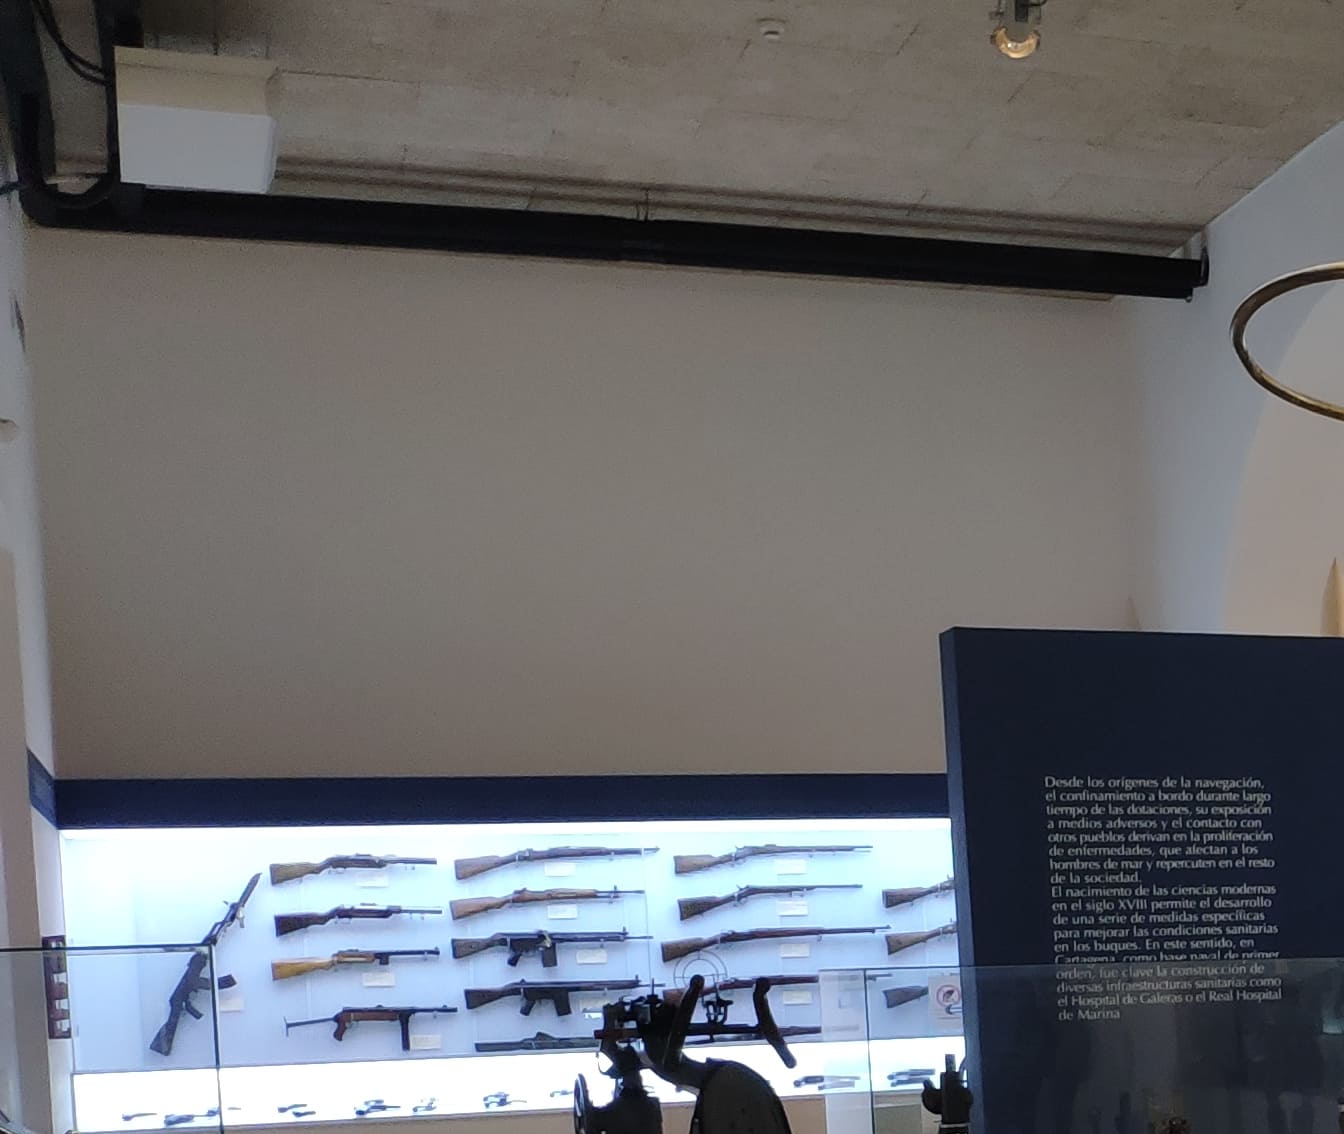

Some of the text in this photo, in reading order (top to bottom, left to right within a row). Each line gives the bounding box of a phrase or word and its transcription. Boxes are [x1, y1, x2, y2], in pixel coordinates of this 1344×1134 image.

[1044, 777, 1083, 788] Desde
[1087, 777, 1104, 788] los
[1162, 777, 1177, 788] de
[1180, 777, 1191, 788] la
[1045, 790, 1056, 801] el
[1059, 790, 1145, 801] confinamiento
[1158, 791, 1193, 801] bordo
[1195, 791, 1239, 801] durante
[1242, 791, 1271, 804] largo
[1046, 805, 1088, 817] tiempo
[1090, 804, 1105, 814] de
[1108, 804, 1124, 814] las
[1195, 806, 1208, 814] su
[1058, 818, 1102, 828] medios
[1105, 817, 1157, 828] adversos
[1171, 817, 1182, 828] el
[1186, 818, 1237, 828] contacto
[1240, 820, 1262, 828] con
[1047, 832, 1077, 842] otros
[1079, 831, 1125, 844] pueblos
[1127, 831, 1170, 841] derivan
[1172, 833, 1187, 841] en
[1190, 831, 1200, 841] la
[1048, 845, 1064, 856] de
[1159, 847, 1181, 858] que
[1185, 844, 1227, 855] afectan
[1241, 844, 1258, 855] los
[1049, 858, 1100, 869] hombres
[1103, 858, 1118, 869] de
[1120, 861, 1142, 869] mar
[1156, 859, 1216, 871] repercuten
[1218, 860, 1232, 868] en
[1235, 858, 1245, 868] el
[1248, 859, 1275, 868] resto
[1050, 872, 1065, 883] de
[1069, 872, 1080, 883] la
[1051, 884, 1276, 896] El nacimiento de las ciencias modernas
[1051, 897, 1272, 913] en el siglo XVIII permite el desarrollo
[1053, 913, 1068, 924] de
[1072, 915, 1094, 923] una
[1098, 913, 1127, 923] serie
[1130, 912, 1145, 923] de
[1149, 911, 1198, 922] medidas
[1053, 924, 1278, 940] para mejorar las condiciones sanitarias
[1054, 943, 1068, 951] en
[1073, 940, 1090, 951] los
[1145, 939, 1160, 949] En
[1163, 939, 1187, 949] este
[1239, 939, 1254, 947] en
